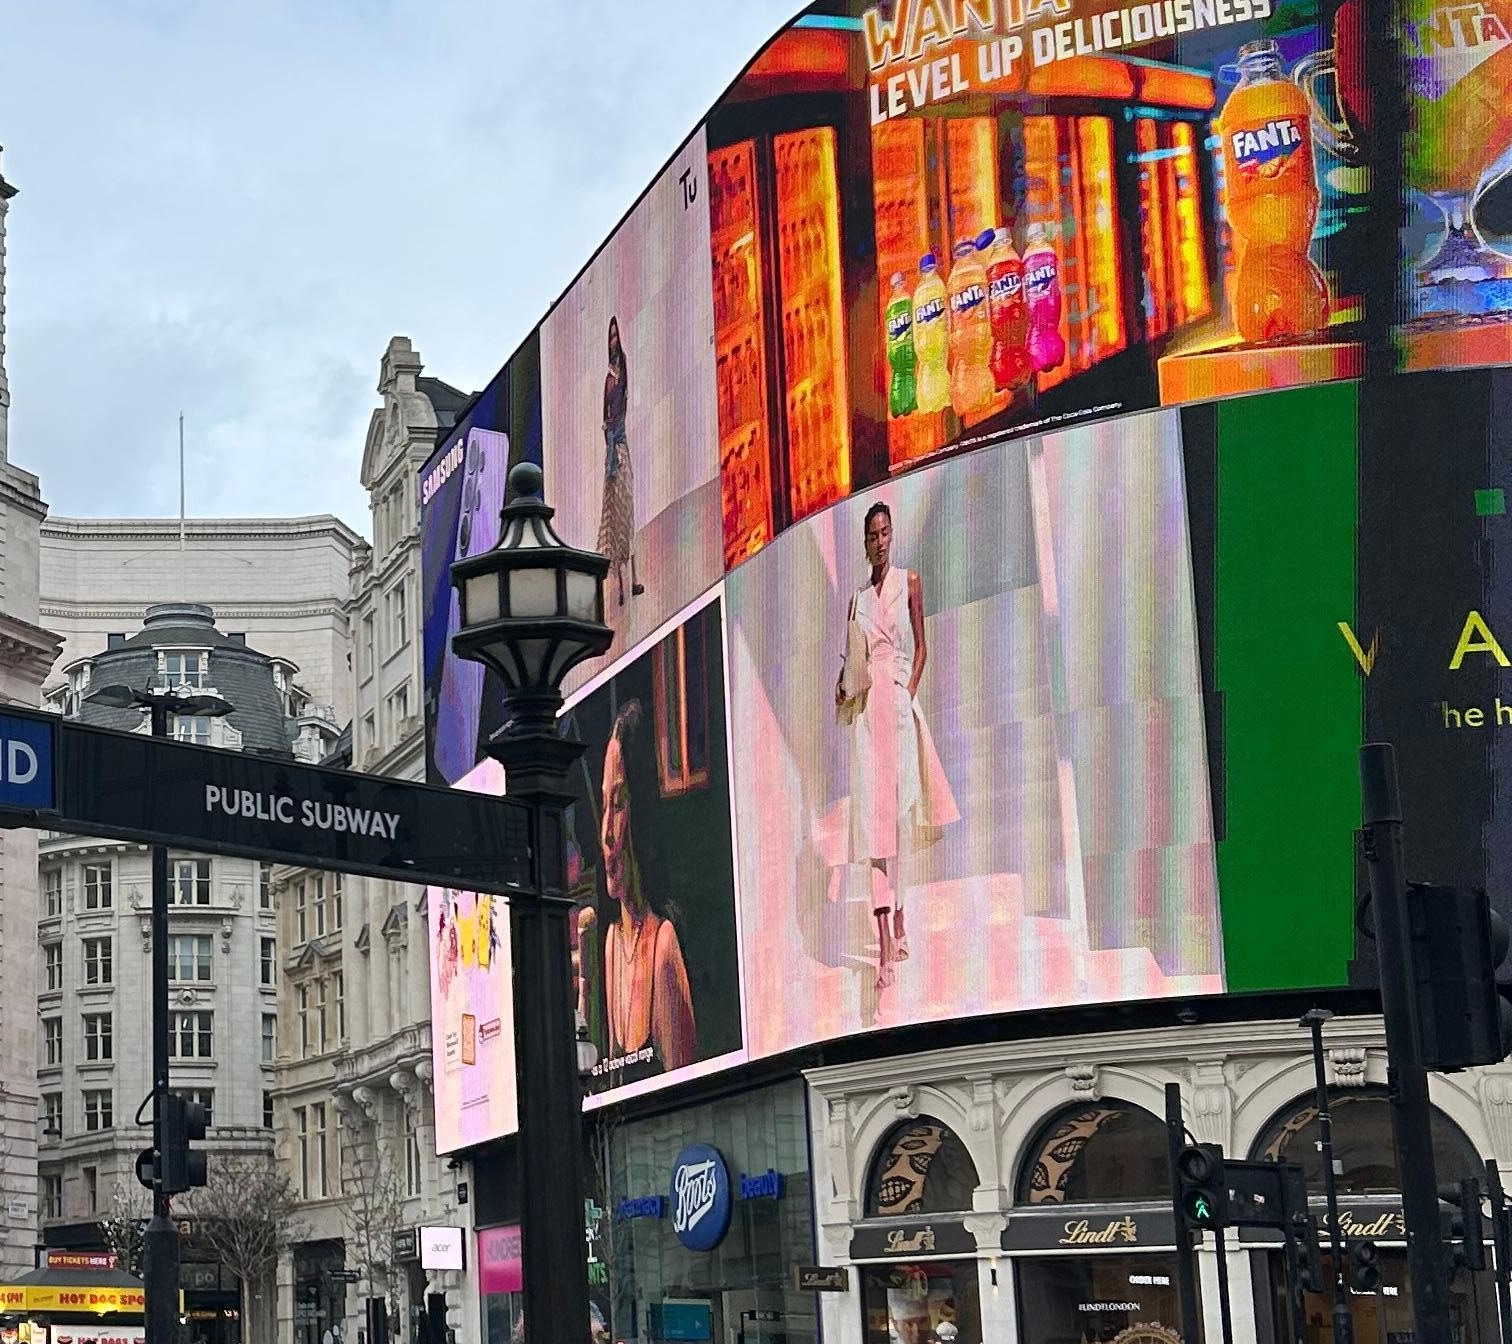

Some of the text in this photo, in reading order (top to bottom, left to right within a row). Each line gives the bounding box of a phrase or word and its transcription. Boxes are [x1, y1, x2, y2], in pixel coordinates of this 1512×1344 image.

[870, 53, 968, 126] LEVEL
[977, 36, 1023, 86] UP
[1232, 119, 1301, 158] FANTA
[679, 167, 697, 211] Tu
[422, 438, 464, 505] SAMSUNG
[205, 785, 400, 840] PUBLIC SUBWAY
[674, 1159, 716, 1233] Boots
[432, 1243, 451, 1252] acer
[1059, 1219, 1122, 1244] Lindt
[59, 1293, 86, 1305] HOT
[89, 1293, 117, 1305] DOG
[119, 1294, 145, 1305] SPO
